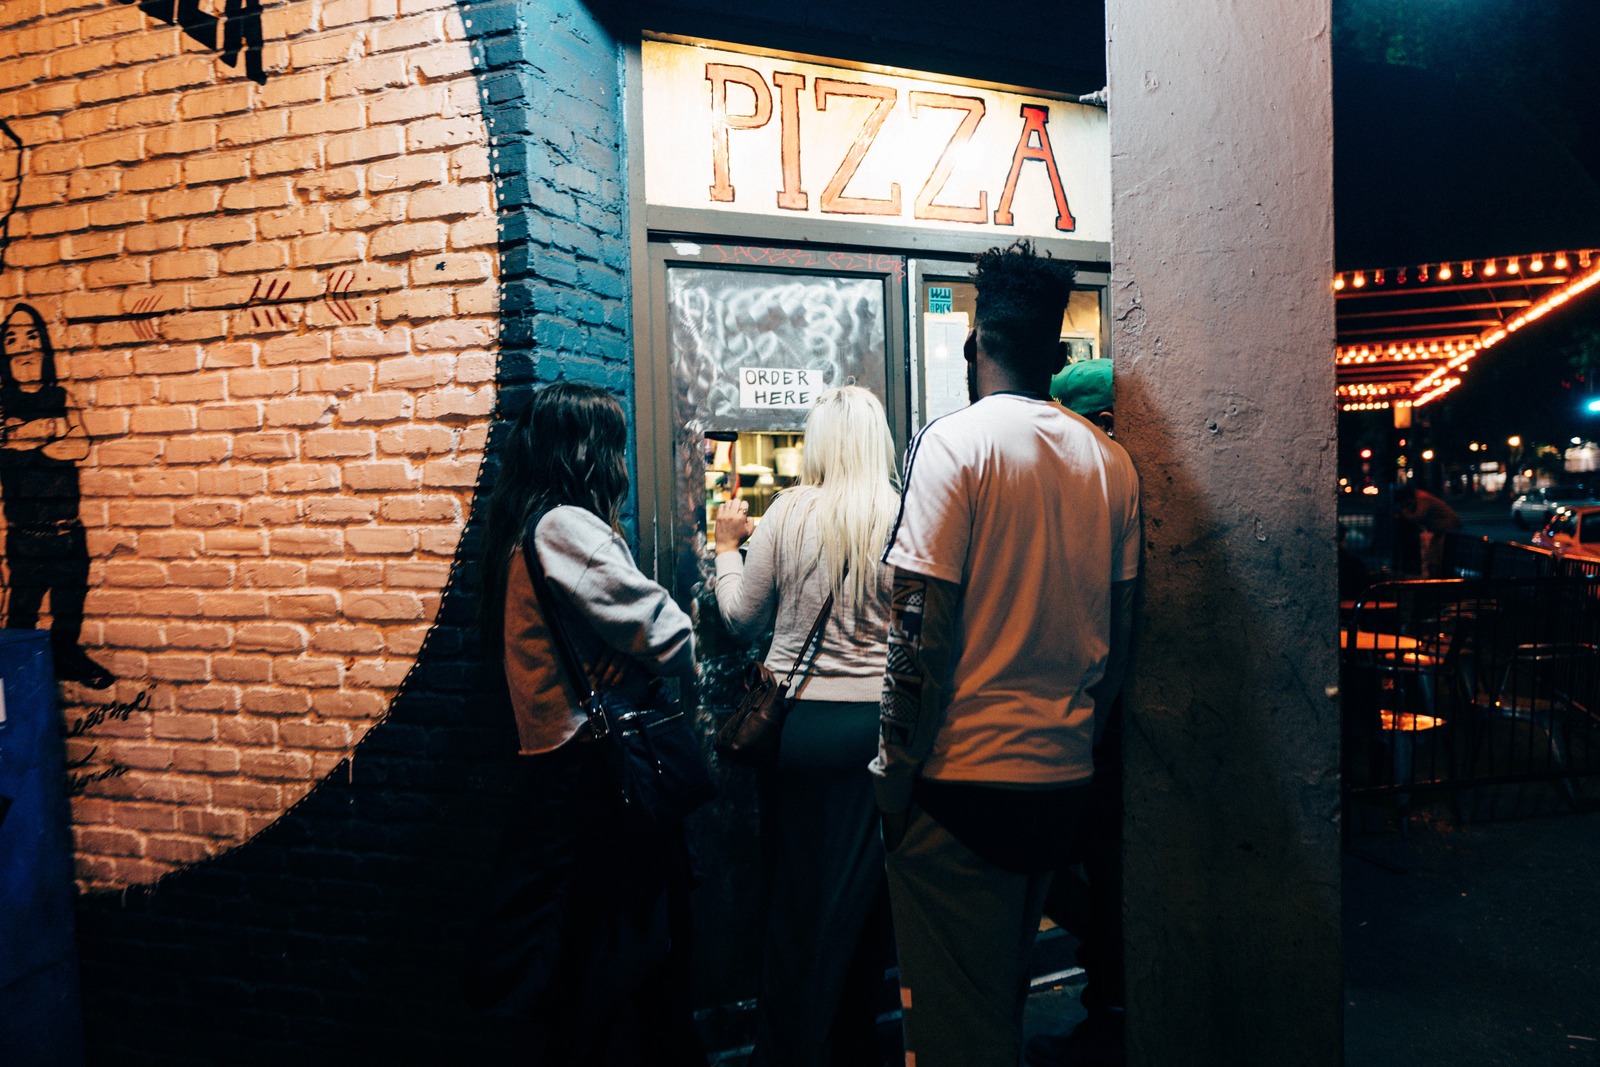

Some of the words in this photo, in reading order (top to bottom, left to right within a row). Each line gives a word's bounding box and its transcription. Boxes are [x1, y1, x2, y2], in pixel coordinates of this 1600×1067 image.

[705, 61, 1076, 232] PIZZA
[745, 369, 809, 386] ORDER
[754, 390, 810, 405] HERE
